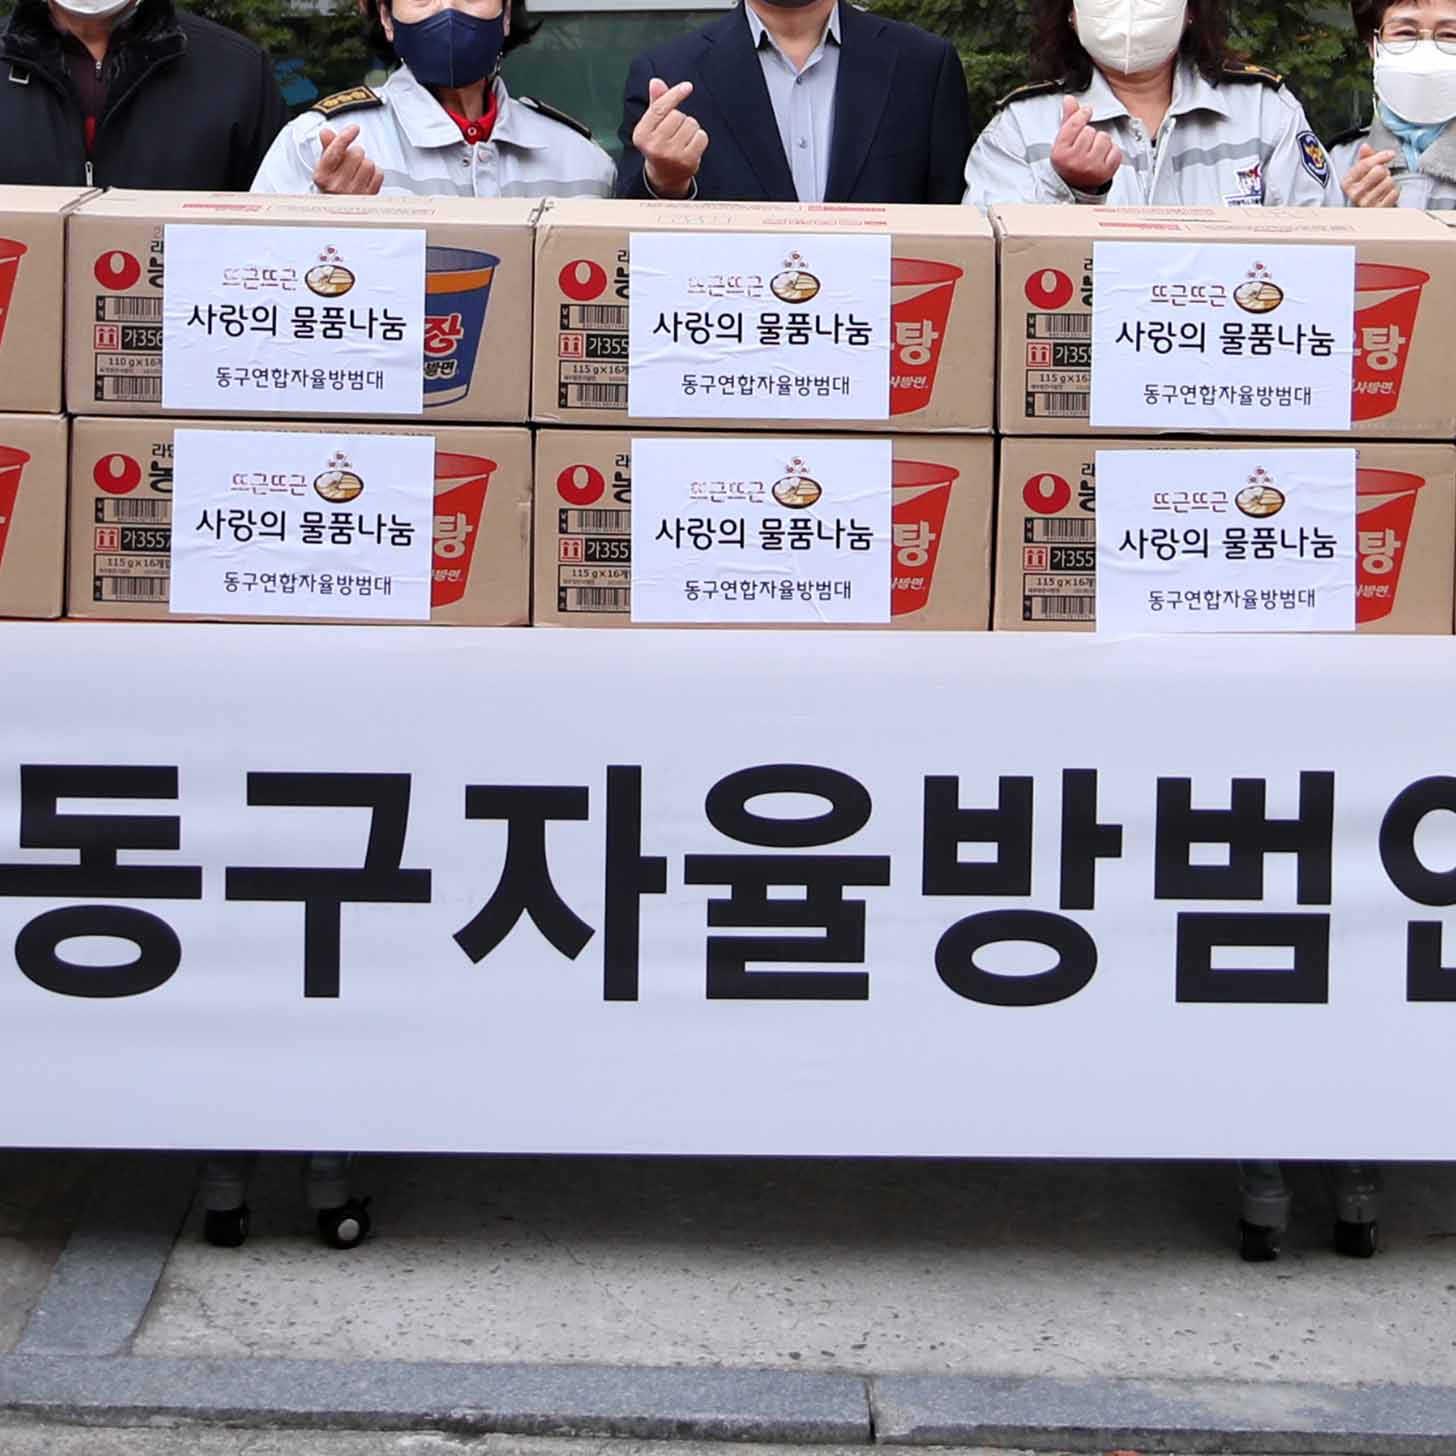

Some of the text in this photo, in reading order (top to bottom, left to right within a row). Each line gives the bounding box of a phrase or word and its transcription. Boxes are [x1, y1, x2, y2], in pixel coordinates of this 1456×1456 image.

[1148, 283, 1229, 309] 뜨근뜨근
[185, 302, 408, 343] 사랑의 물품나눔
[651, 310, 874, 347] 사랑의 물품나눔
[123, 327, 162, 347] 가356
[588, 335, 629, 355] 가355
[891, 319, 939, 366] 탕
[1114, 319, 1337, 358] 사랑의 물품나눔
[1352, 323, 1406, 372] 탕
[214, 365, 385, 392] 동구연합자율방범대
[680, 373, 851, 398] 동구연합자율방범대
[1142, 382, 1313, 408] 동구연합자율방범대
[1150, 489, 1230, 515] 뜨근뜨근
[194, 507, 417, 548] 사랑의 물품나눔
[654, 516, 875, 552] 사랑의 물품나눔
[587, 540, 629, 560] 가355
[1117, 525, 1339, 562] 사랑의 물품나눔
[1052, 548, 1094, 568] 가355
[222, 570, 393, 598] 동구연합자율방범대
[682, 578, 853, 602] 동구연합자율방범대
[1147, 587, 1317, 613] 동구연합자율방범대
